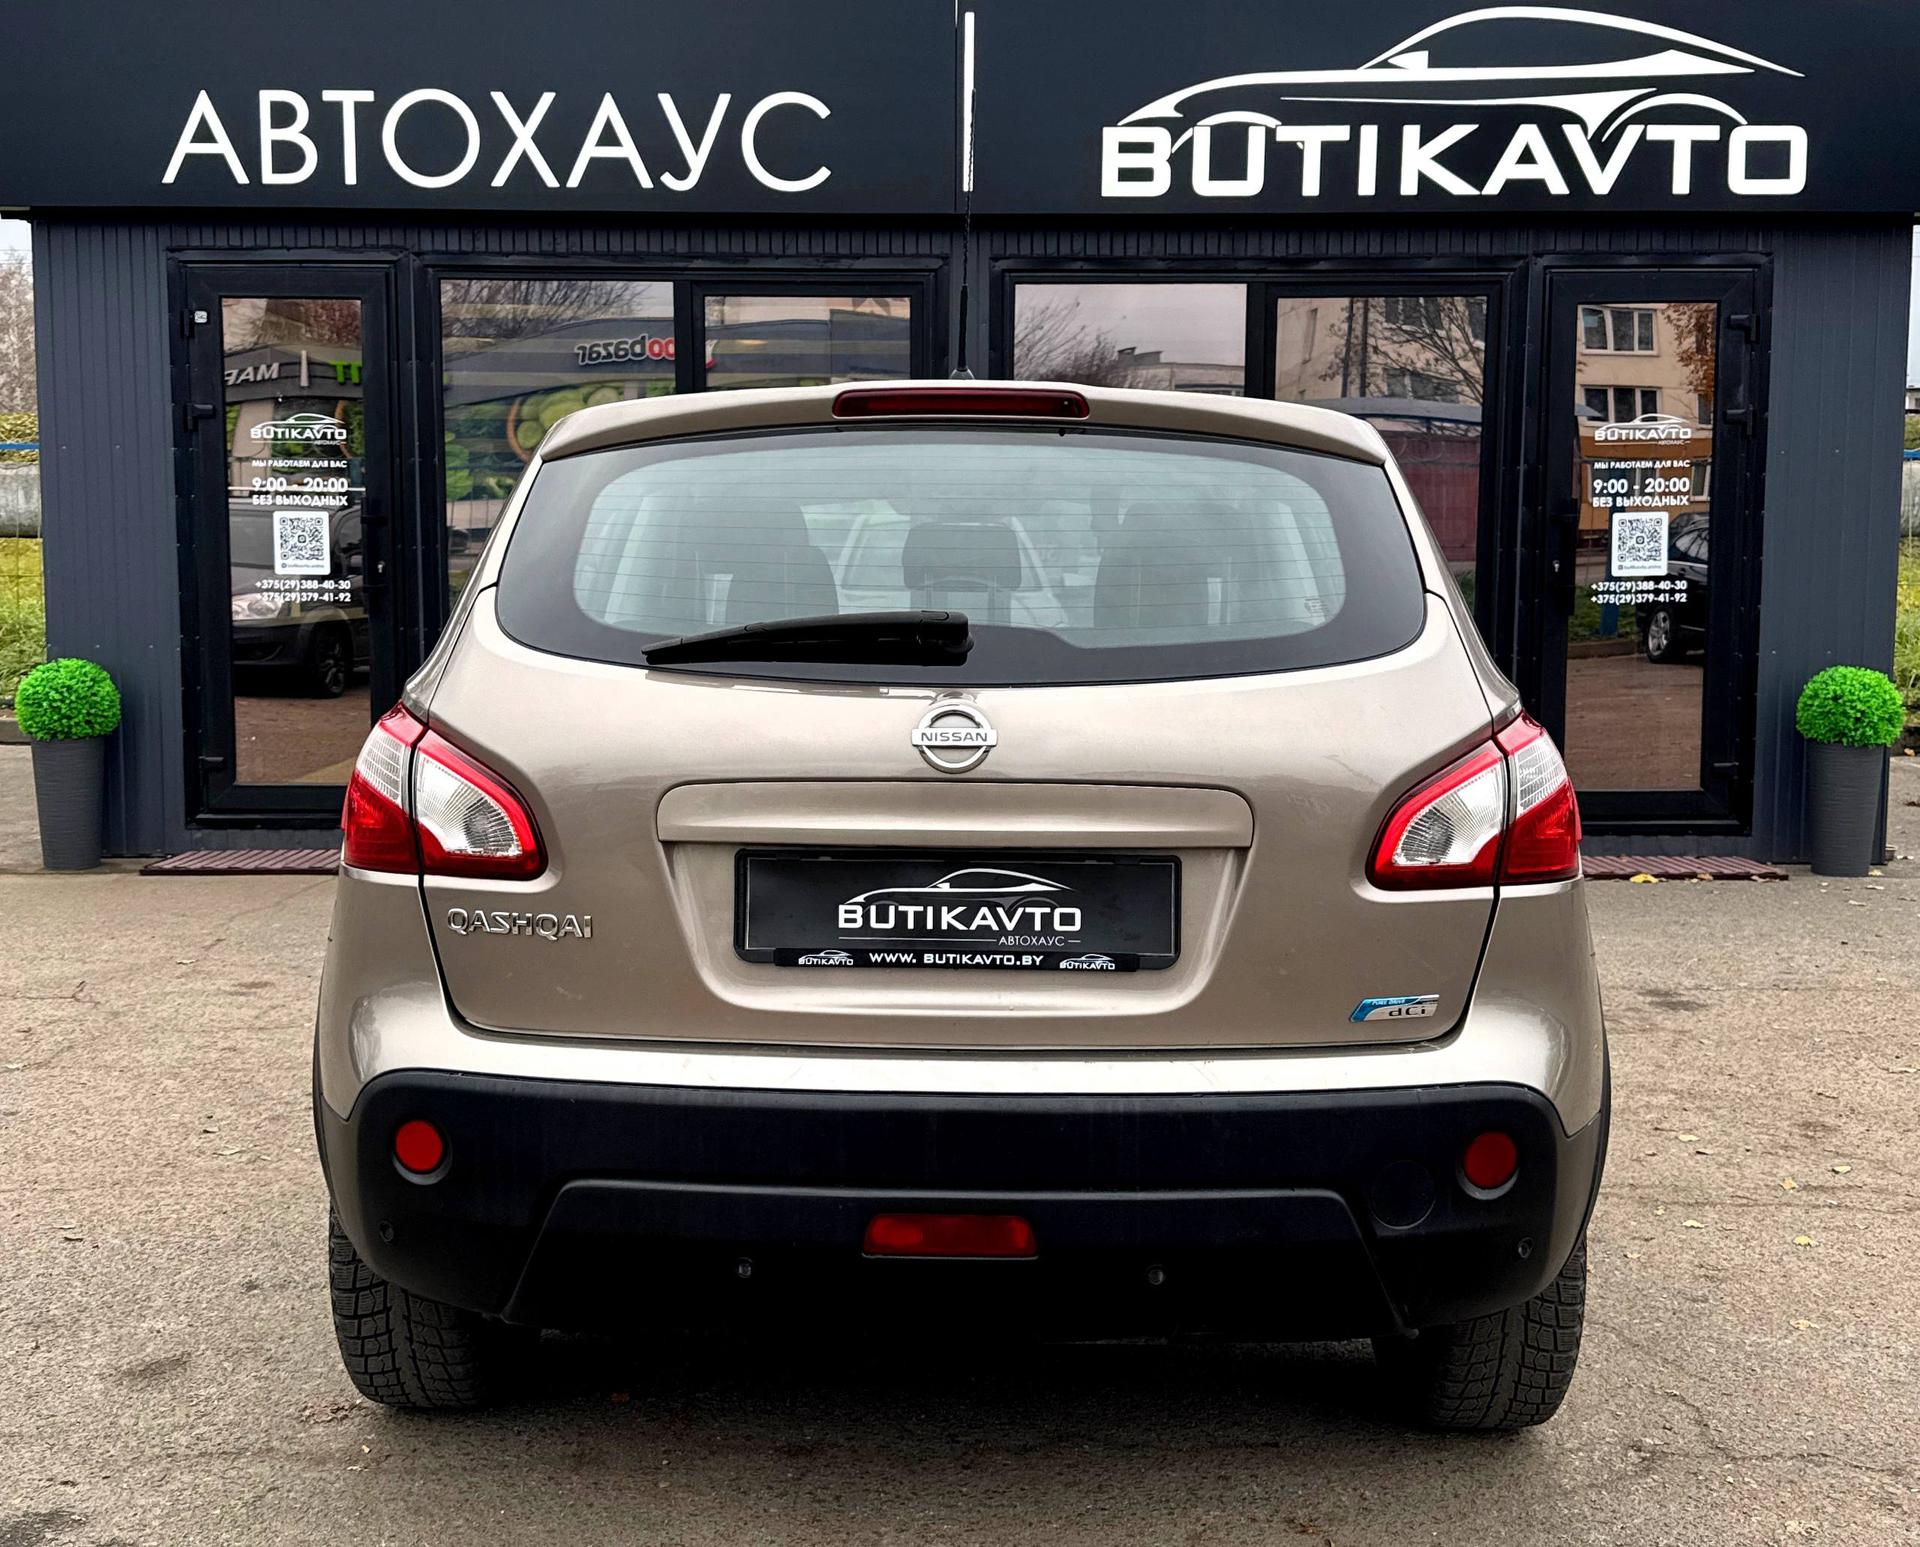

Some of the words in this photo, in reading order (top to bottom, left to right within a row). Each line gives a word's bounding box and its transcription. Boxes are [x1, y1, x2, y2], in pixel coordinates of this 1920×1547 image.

[161, 88, 832, 193] АВТОХАУС
[1101, 124, 1809, 197] BUTIKAVTO
[250, 427, 347, 440] BUTIKAVTO
[1594, 427, 1692, 441] BUTIKAVTO
[268, 460, 310, 468] РАБОТАЕМ
[311, 460, 328, 468] ДЛЯ
[330, 460, 347, 468] ВАС
[1593, 461, 1608, 469] МЫ
[1610, 461, 1653, 469] РАБОТАЕМ
[1654, 460, 1671, 468] ДЛЯ
[1673, 459, 1691, 468] ВАС
[252, 477, 287, 492] 9:00
[303, 477, 348, 493] 20:00
[1593, 478, 1629, 494] 9:00
[1644, 477, 1690, 493] 20:00
[252, 494, 273, 505] БЕЗ
[275, 494, 348, 507] ВЫХОДНЫХ
[1592, 496, 1613, 508] БЕЗ
[1615, 495, 1690, 508] ВЫХОДНЫХ
[255, 580, 351, 591] +375(29)388-40-30
[1590, 580, 1688, 593] +375(29)388-40-30
[256, 592, 352, 604] +375(29)379-41-92
[1590, 593, 1688, 605] +375(29)379-41-92
[920, 732, 988, 742] NISSAN
[447, 908, 593, 941] QASHQAI
[838, 904, 1082, 932] BUTIKAVTO
[998, 935, 1065, 947] АВТОХАУС
[798, 957, 854, 966] BUTIKAVTO
[869, 952, 917, 964] WWW.
[923, 953, 1044, 966] BUTIKAVTO.BY
[1059, 961, 1116, 970] BUTIKAVTO
[1388, 1006, 1426, 1017] dCi
